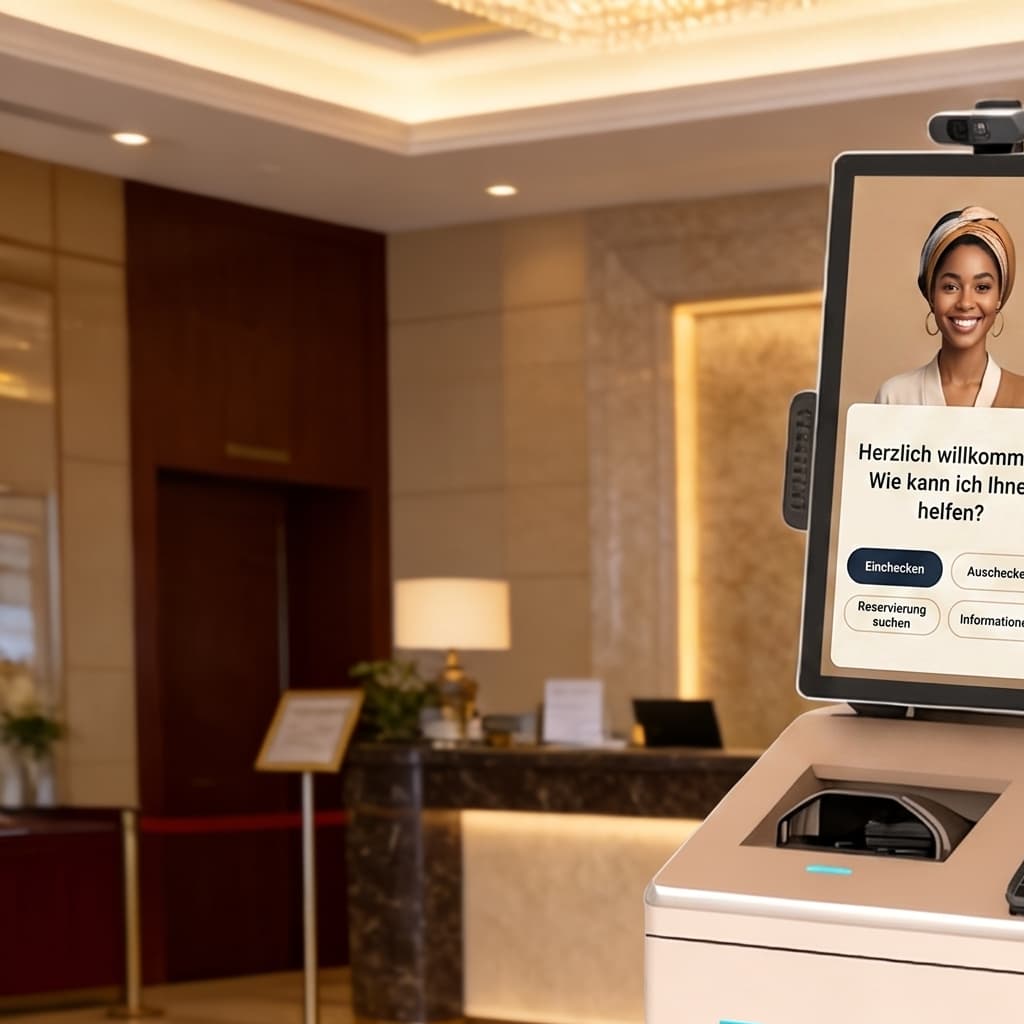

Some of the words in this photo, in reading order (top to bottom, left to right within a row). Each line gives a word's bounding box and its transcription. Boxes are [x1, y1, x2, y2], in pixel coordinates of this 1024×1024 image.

[858, 443, 932, 463] Herzlich
[869, 472, 901, 490] Wie
[906, 472, 950, 492] kann
[956, 475, 982, 493] ich
[917, 501, 984, 521] helfen?
[865, 560, 925, 575] Einchecken
[857, 600, 927, 617] Reservierung
[872, 617, 911, 629] suchen
